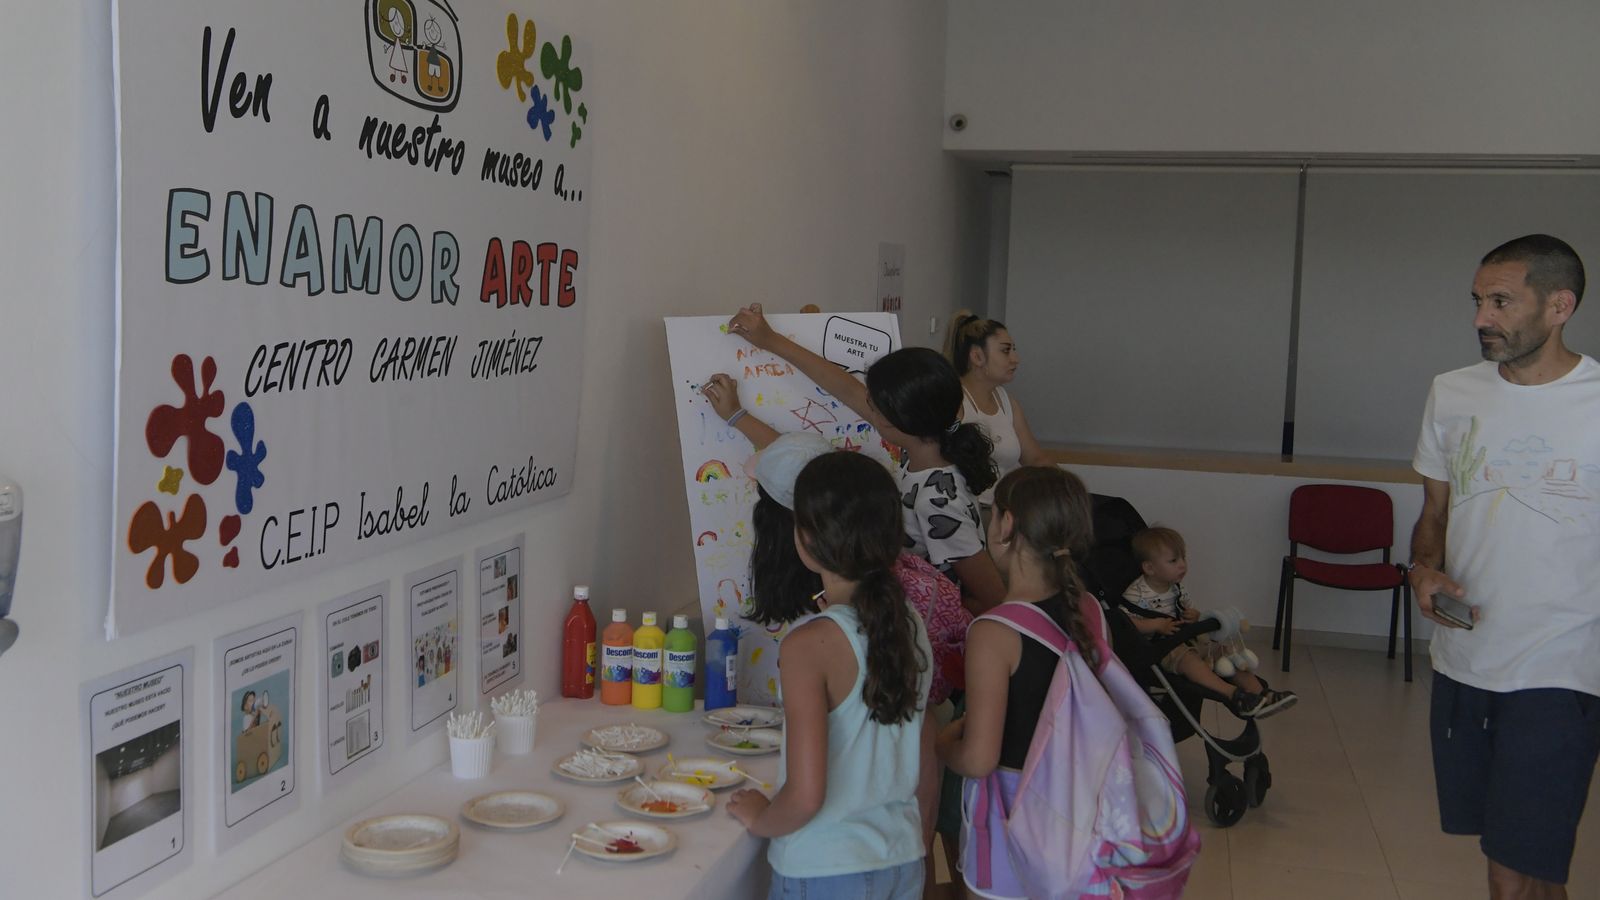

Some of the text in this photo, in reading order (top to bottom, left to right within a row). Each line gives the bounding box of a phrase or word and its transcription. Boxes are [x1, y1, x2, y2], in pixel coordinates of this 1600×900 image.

[201, 26, 583, 202] Ven a nuestro museo a...
[165, 188, 579, 309] ENAMOR ARTE
[834, 332, 879, 352] MUESTRA TU
[846, 347, 865, 359] ARTE
[244, 329, 543, 398] CENTRO CARMEN JIMÉNEZ
[260, 456, 557, 570] C.E.I.P Isabel la Católica
[373, 731, 379, 742] 3
[280, 780, 286, 792] 2
[171, 837, 176, 849] 1
